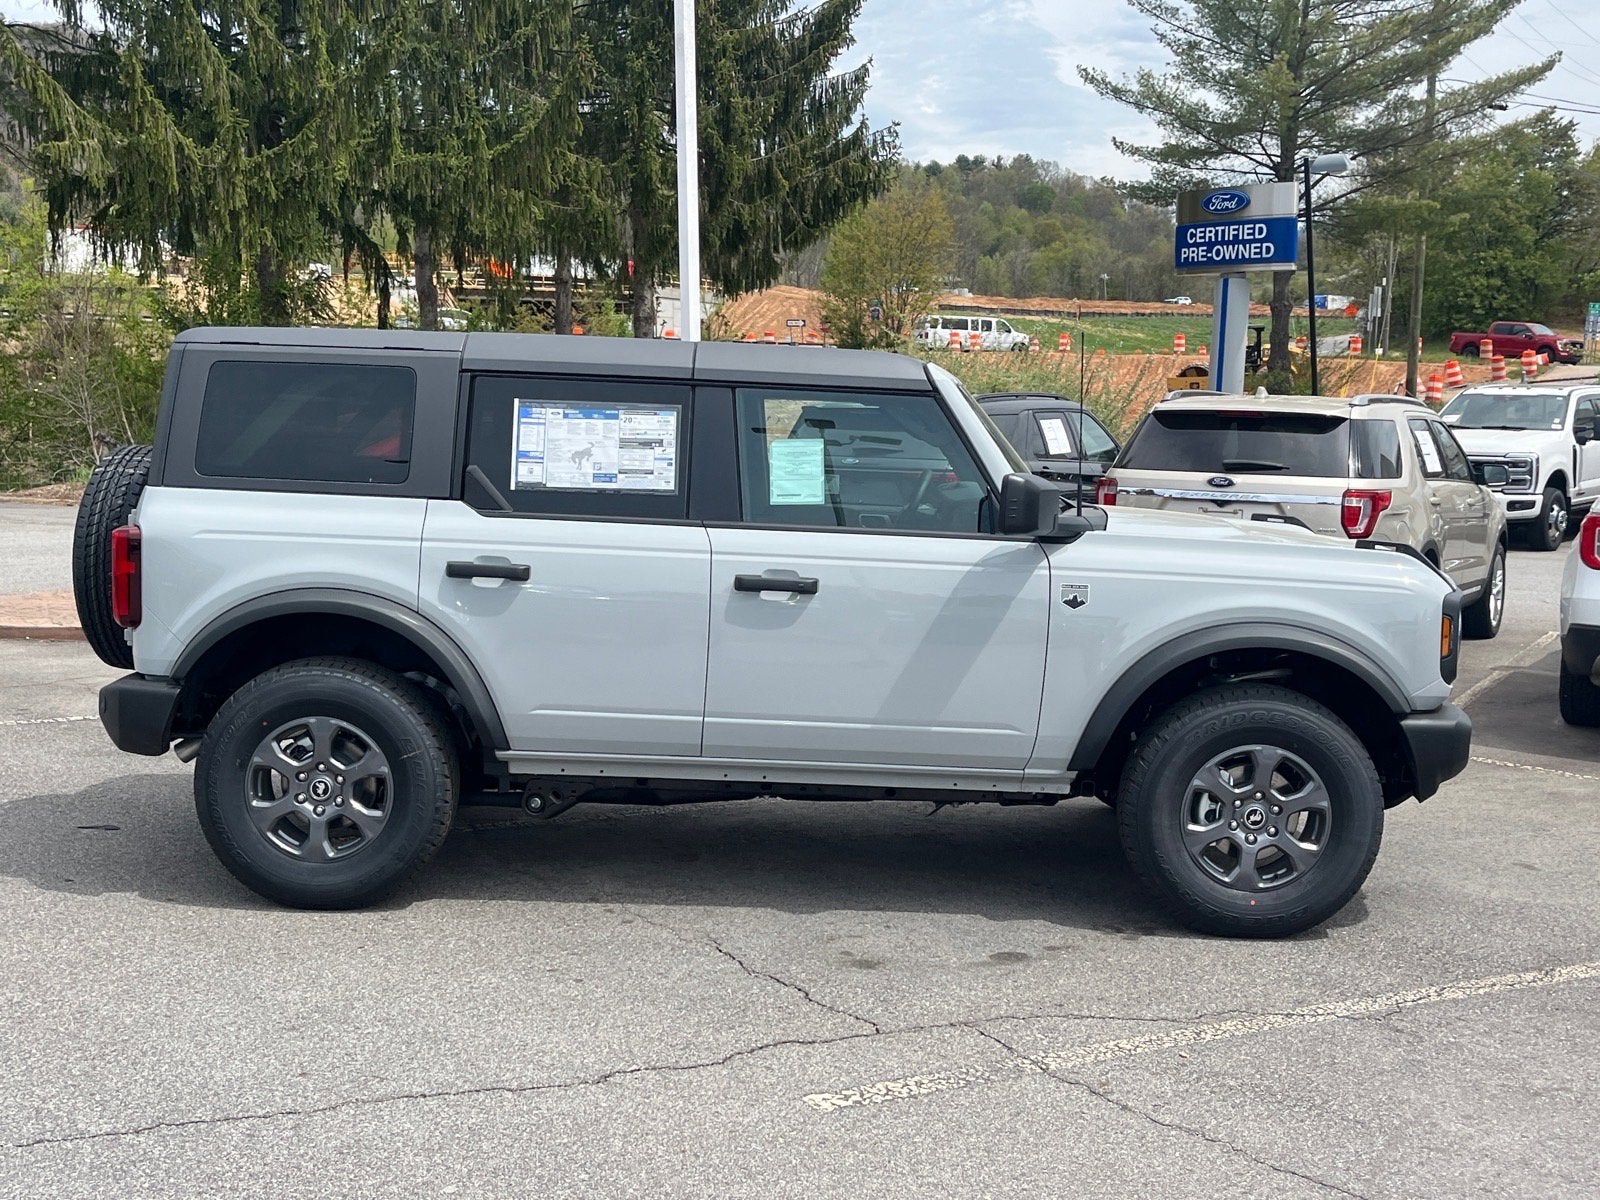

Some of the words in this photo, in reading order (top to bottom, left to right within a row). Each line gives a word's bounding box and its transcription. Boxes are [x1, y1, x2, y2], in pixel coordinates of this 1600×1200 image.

[1209, 194, 1238, 210] Ford
[1187, 223, 1267, 244] CERTIFIED
[1181, 242, 1275, 262] PRE-OWNED
[1178, 491, 1262, 500] EXPLORER
[1185, 710, 1351, 769] BRIDGESTONE
